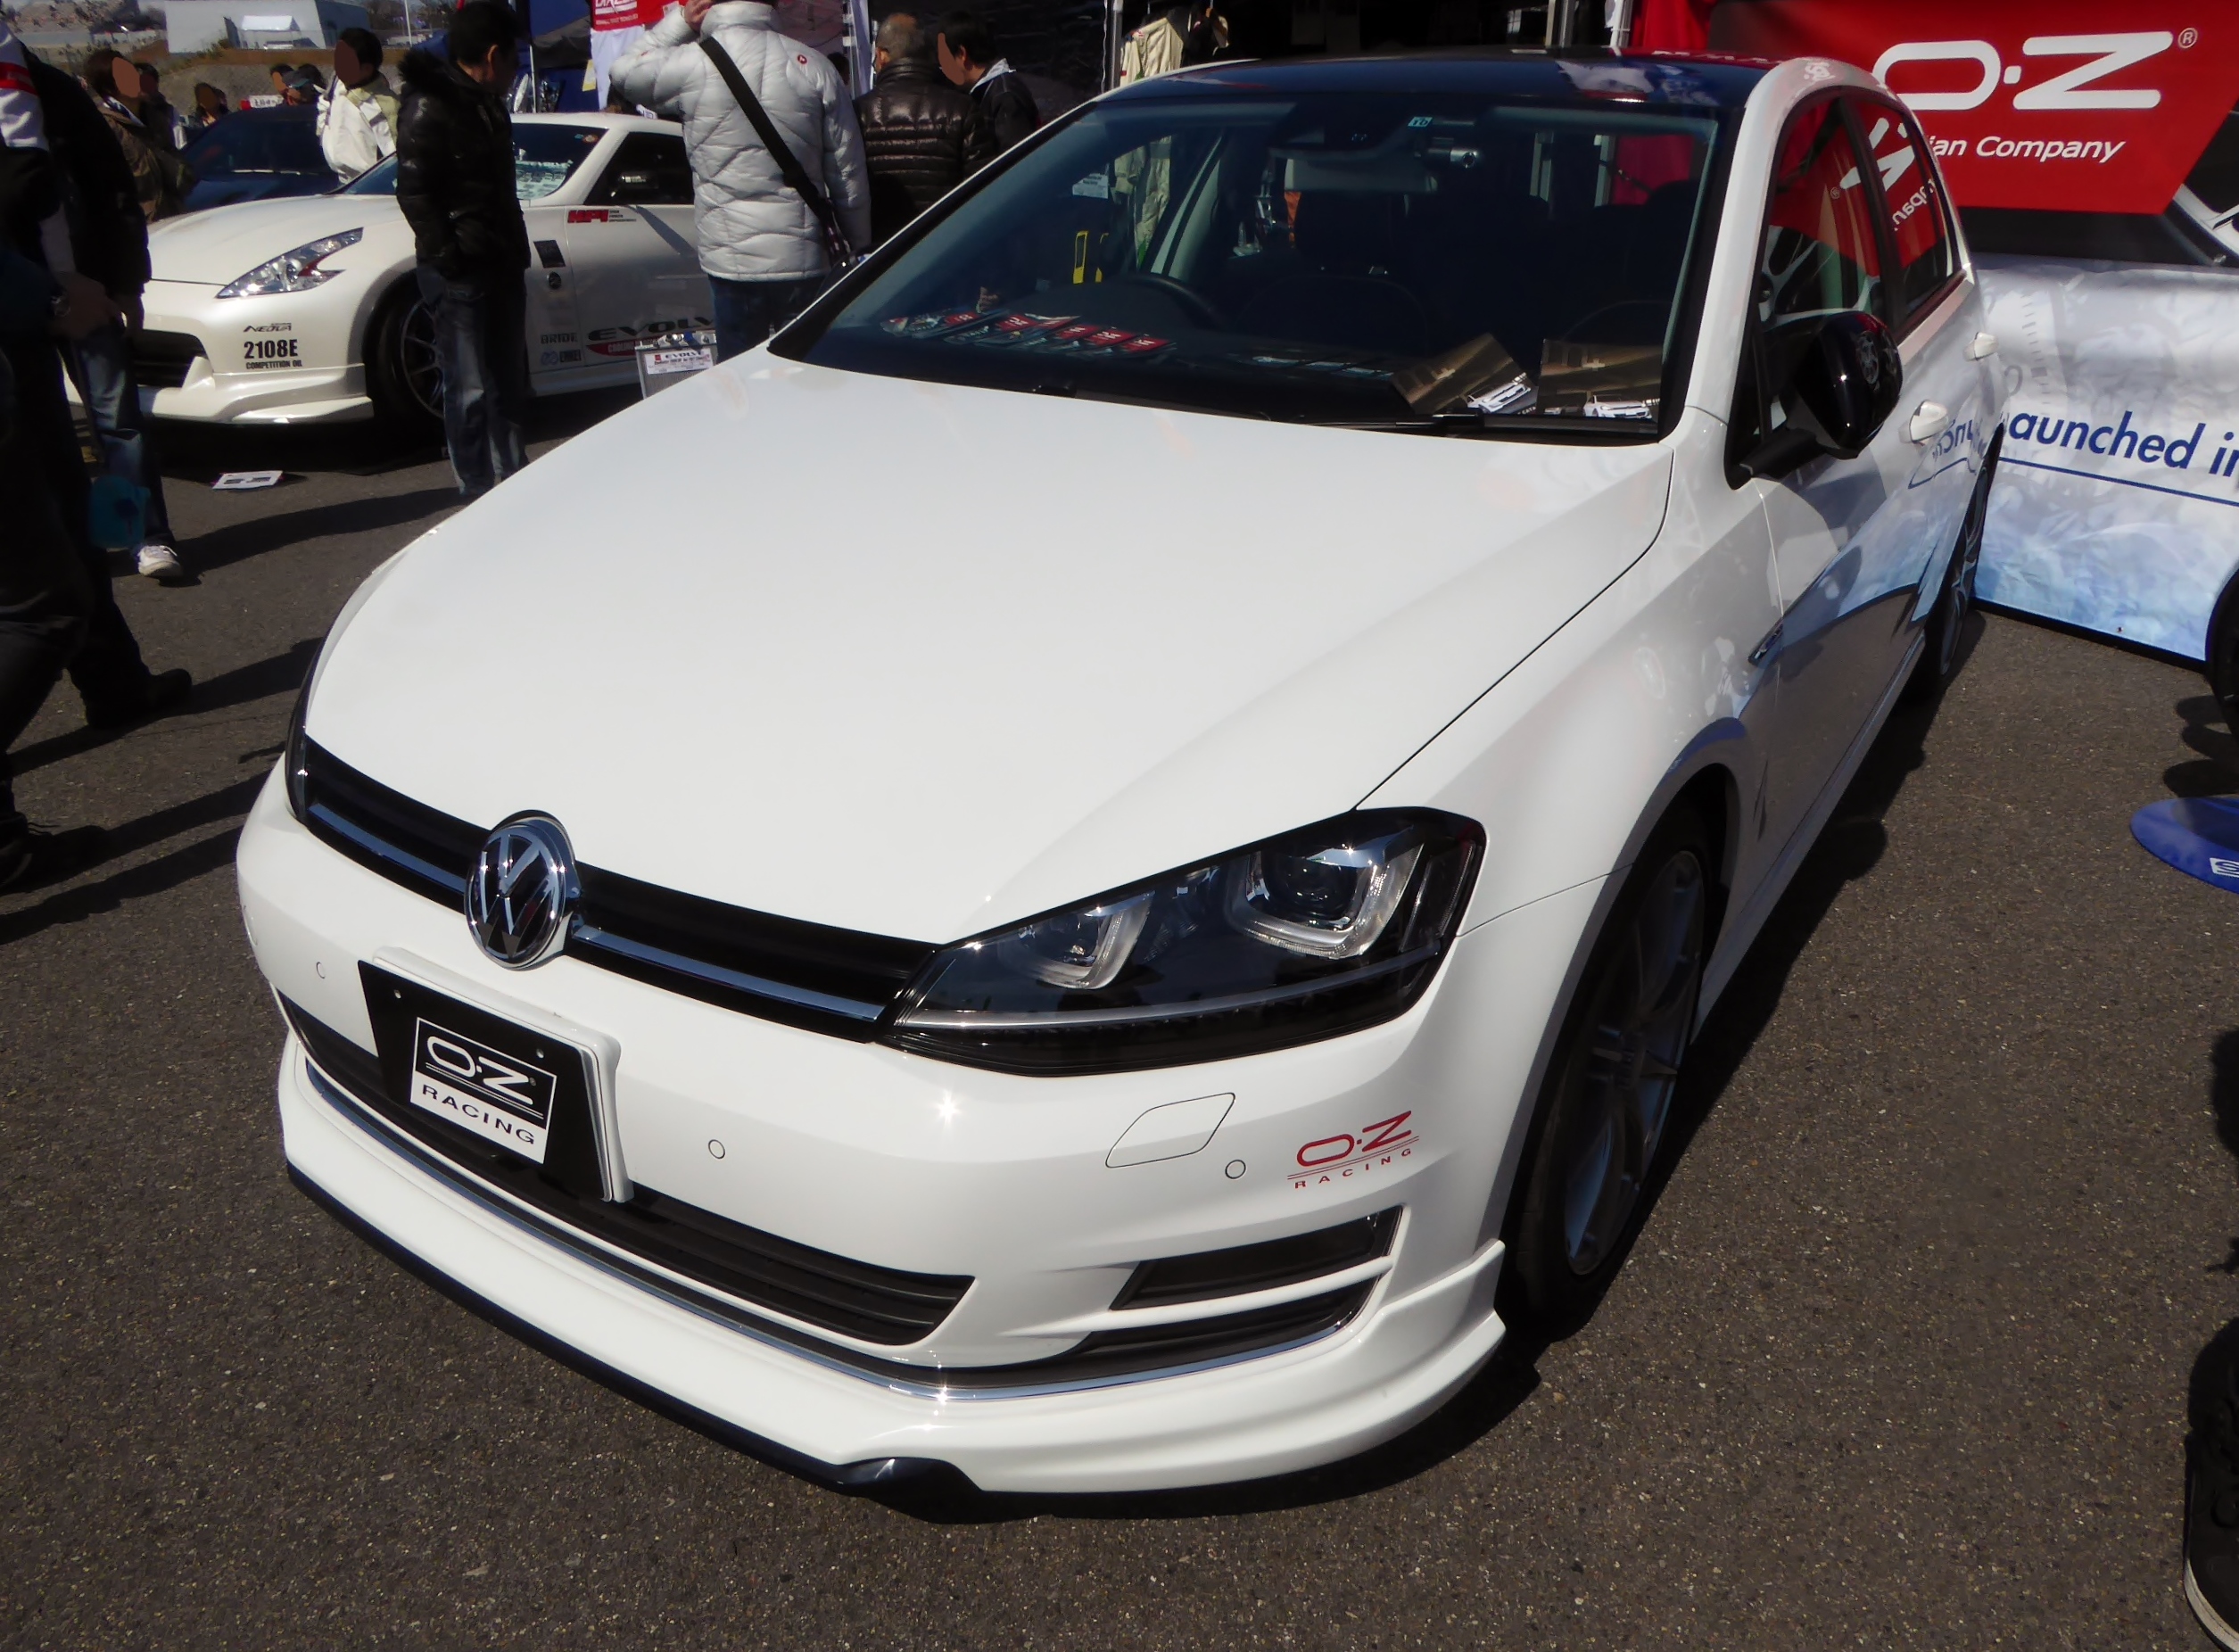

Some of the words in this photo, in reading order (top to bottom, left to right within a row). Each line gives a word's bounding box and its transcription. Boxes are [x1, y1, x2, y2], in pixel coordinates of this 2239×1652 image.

[1976, 136, 2126, 163] Company
[588, 317, 714, 341] EVOLV
[244, 339, 298, 359] 2108E
[245, 360, 291, 369] COMPETITION
[292, 359, 303, 368] OIL
[2007, 410, 2206, 470] aunched
[422, 1084, 535, 1144] RACING
[1294, 1148, 1412, 1188] RACING
